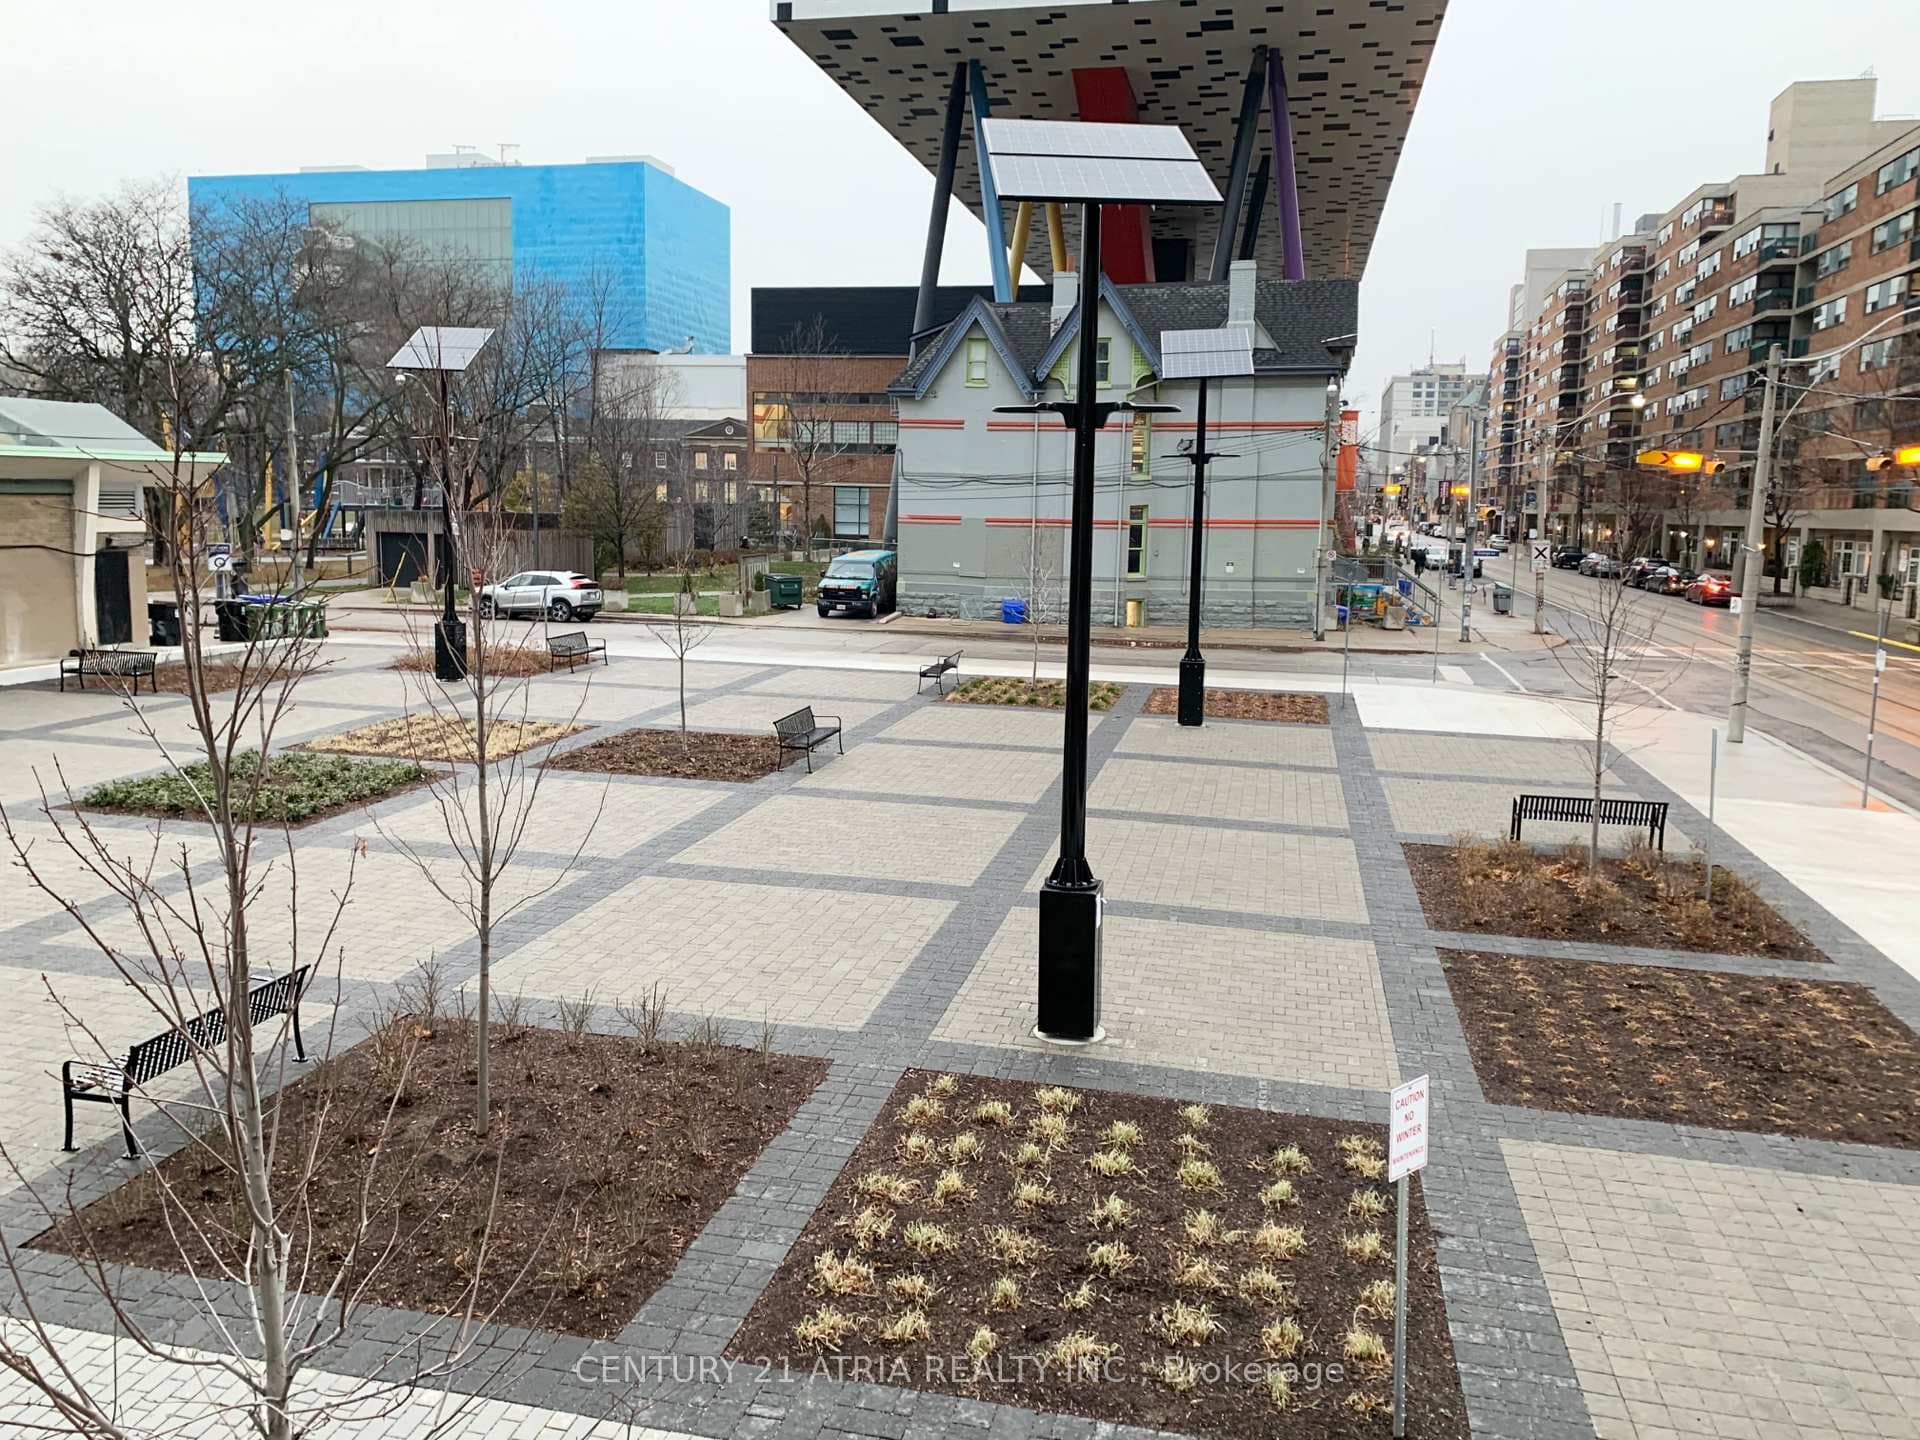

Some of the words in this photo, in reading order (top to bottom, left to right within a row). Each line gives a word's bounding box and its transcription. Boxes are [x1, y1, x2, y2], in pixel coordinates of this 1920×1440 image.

[1395, 1089, 1425, 1110] CAUTION
[1404, 1111, 1415, 1122] NO
[1396, 1124, 1423, 1143] WINTER
